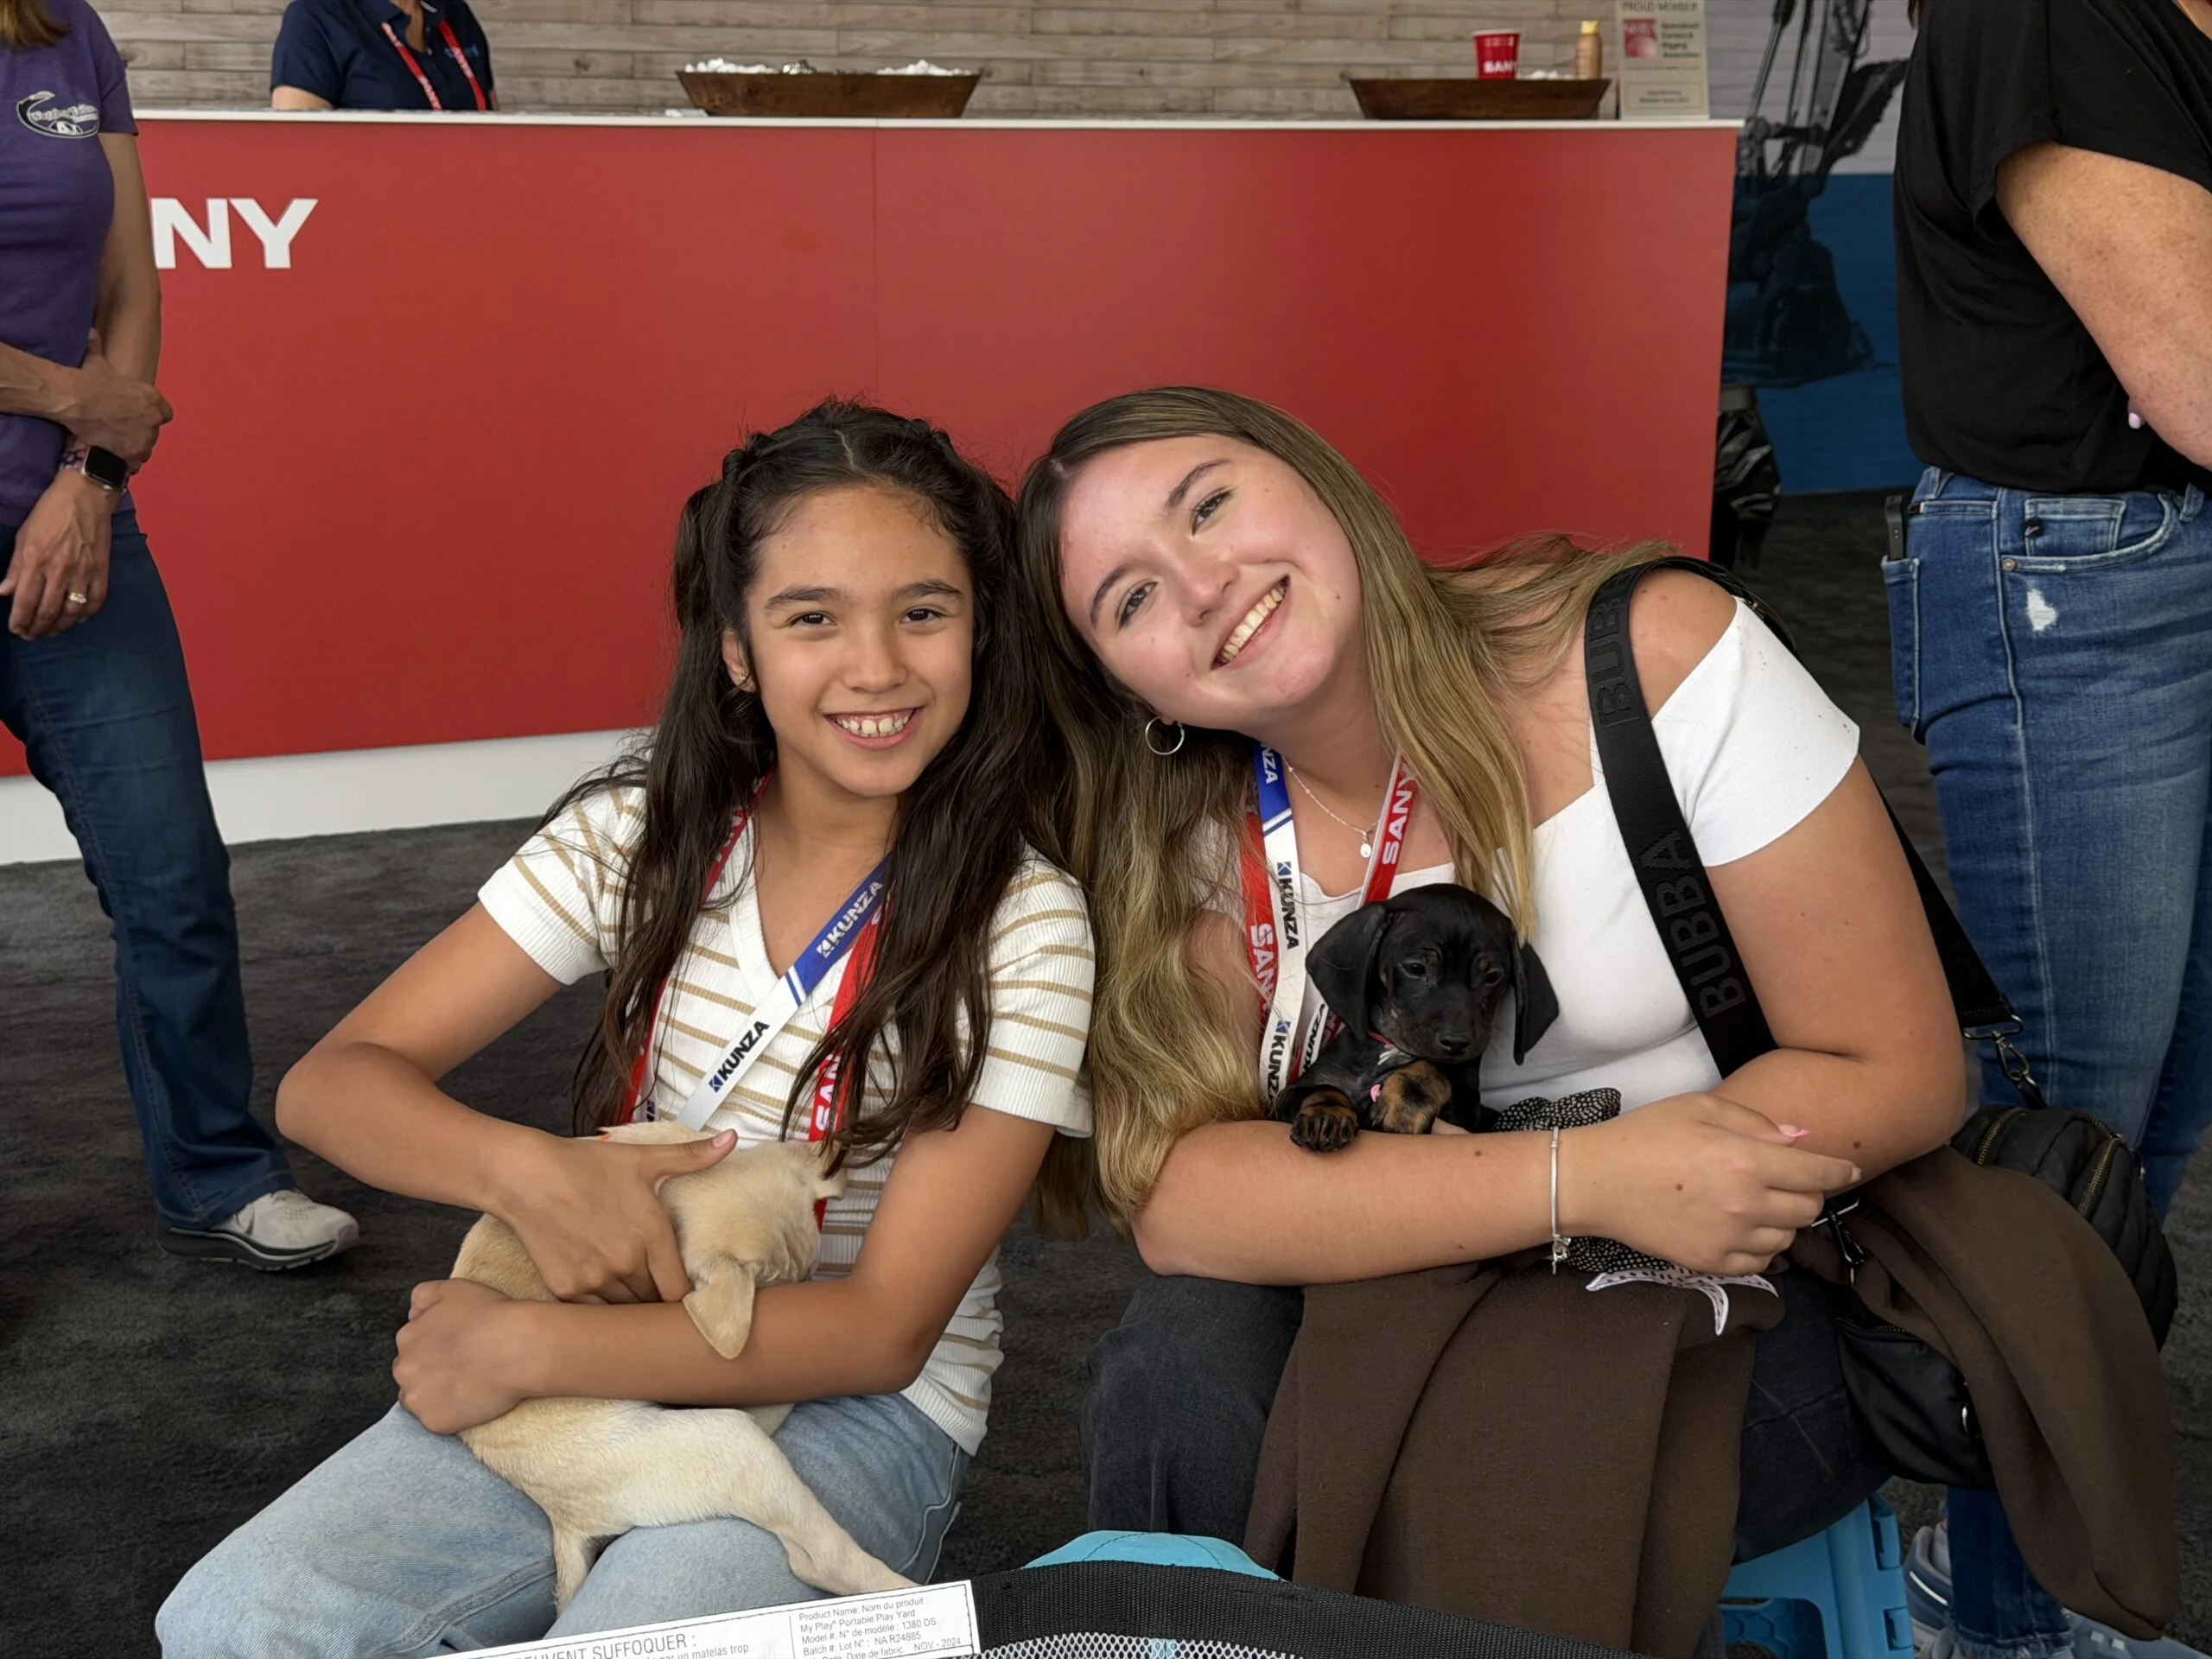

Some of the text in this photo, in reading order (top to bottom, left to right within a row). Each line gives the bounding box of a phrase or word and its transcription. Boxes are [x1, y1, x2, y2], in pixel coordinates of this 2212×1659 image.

[827, 881, 883, 945] KUNZA
[1278, 878, 1300, 950] KUNZA
[1639, 830, 1746, 1019] BUBBA
[1250, 922, 1274, 1011] SAN
[716, 1020, 771, 1082] KUNZA
[1267, 1034, 1287, 1103] KUNZ
[799, 1611, 830, 1622] Product
[833, 1607, 860, 1617] Name:
[895, 1597, 924, 1609] produit
[839, 1615, 874, 1627] Portable
[896, 1609, 914, 1618] Yard
[802, 1633, 827, 1644] Model
[865, 1624, 894, 1635] modèle
[902, 1619, 921, 1630] 1380
[924, 1618, 936, 1626] DS
[804, 1645, 827, 1656] Batch
[839, 1641, 852, 1650] Lot
[874, 1636, 887, 1645] NA
[890, 1630, 921, 1643] R24885
[593, 1633, 686, 1659] SUFFOQUER
[692, 1646, 727, 1659] matelas
[730, 1643, 748, 1654] trop
[868, 1649, 878, 1658] de
[913, 1641, 933, 1651] NOV
[941, 1637, 960, 1647] 2024
